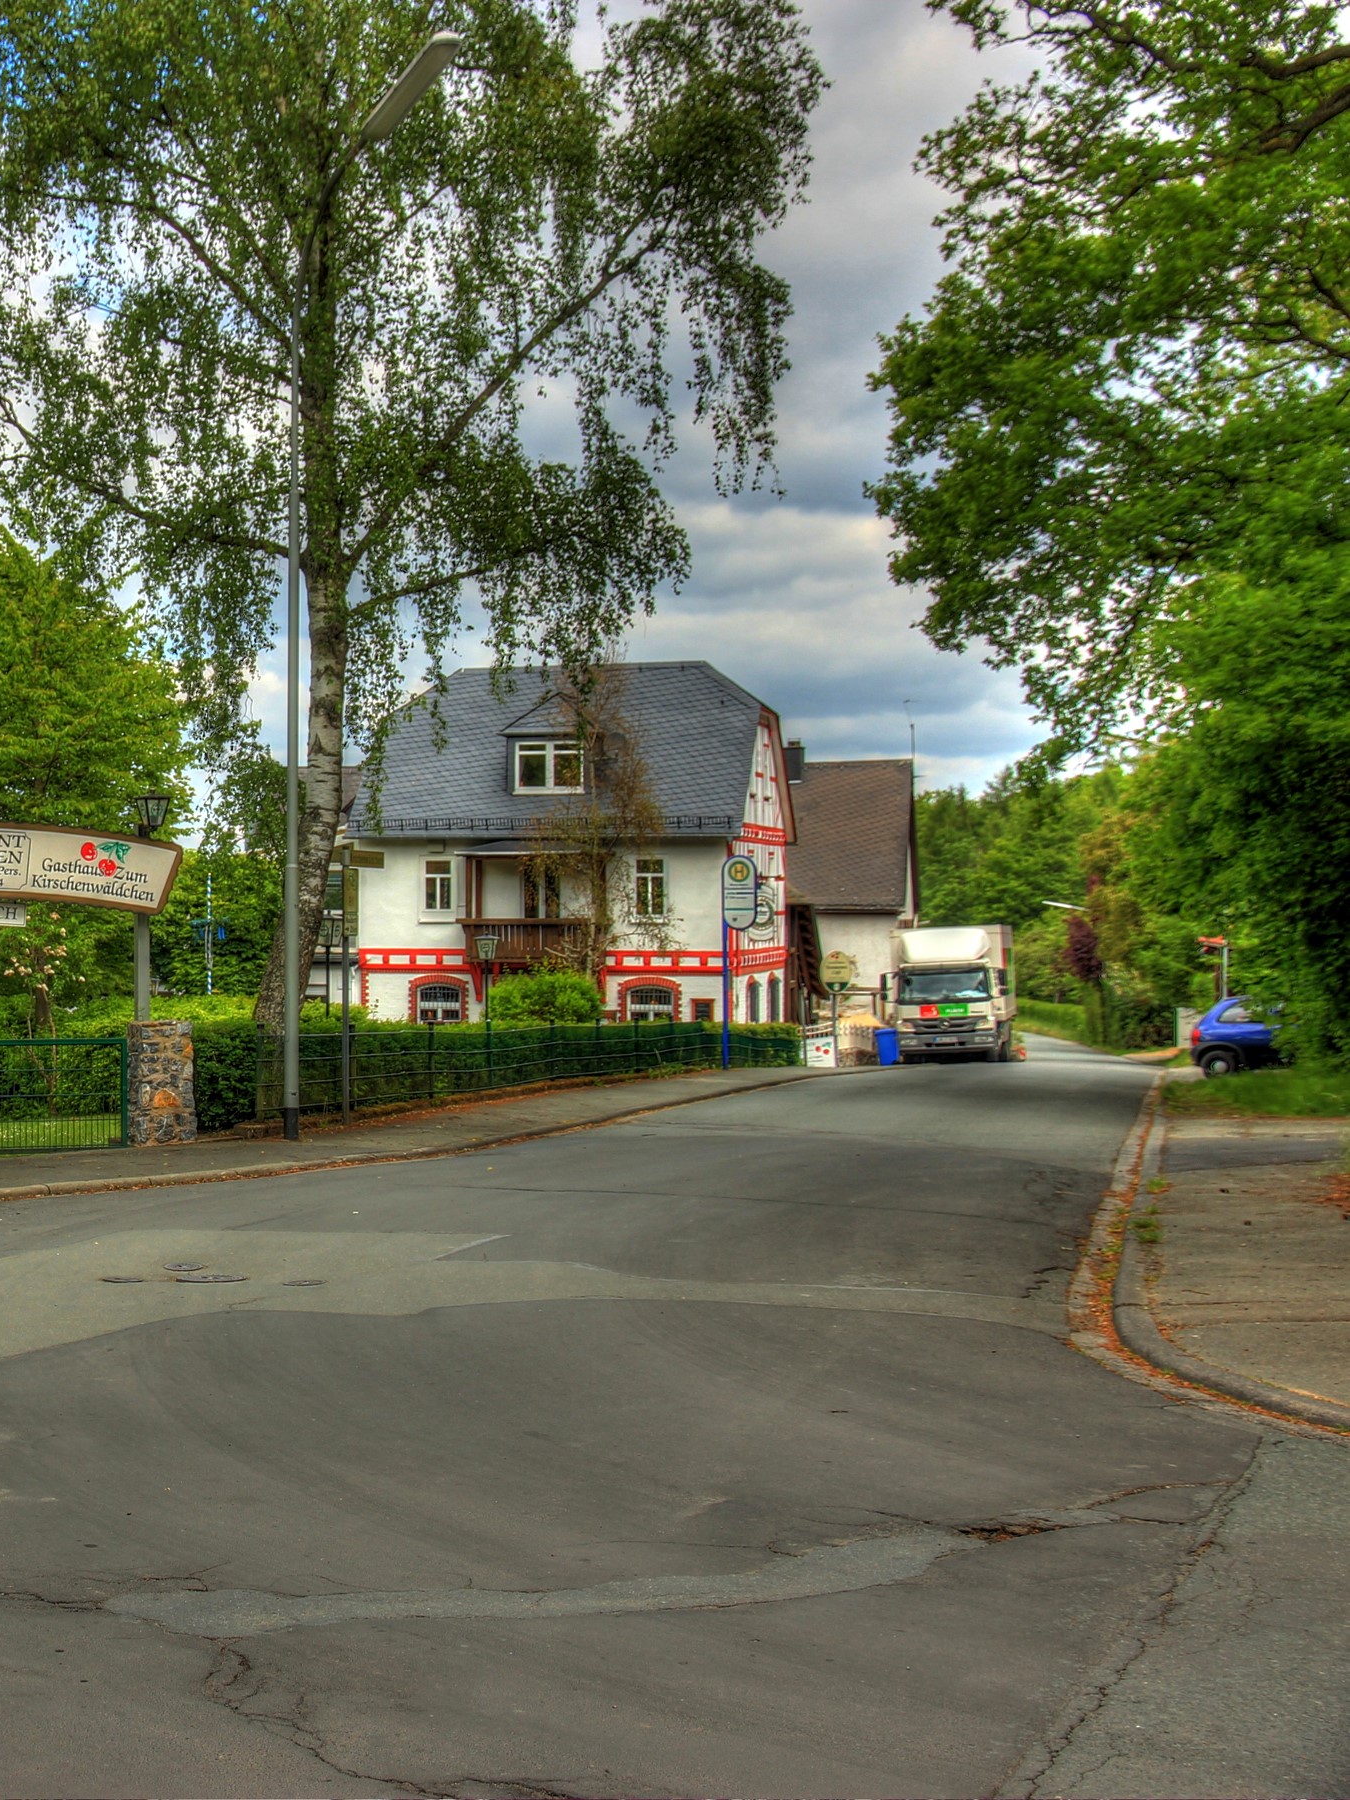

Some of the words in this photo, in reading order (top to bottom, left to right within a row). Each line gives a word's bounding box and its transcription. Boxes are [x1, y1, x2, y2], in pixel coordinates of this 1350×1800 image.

[41, 857, 105, 877] Gasthaus
[114, 866, 149, 883] Zum
[31, 874, 155, 902] Kirschenwäldchen
